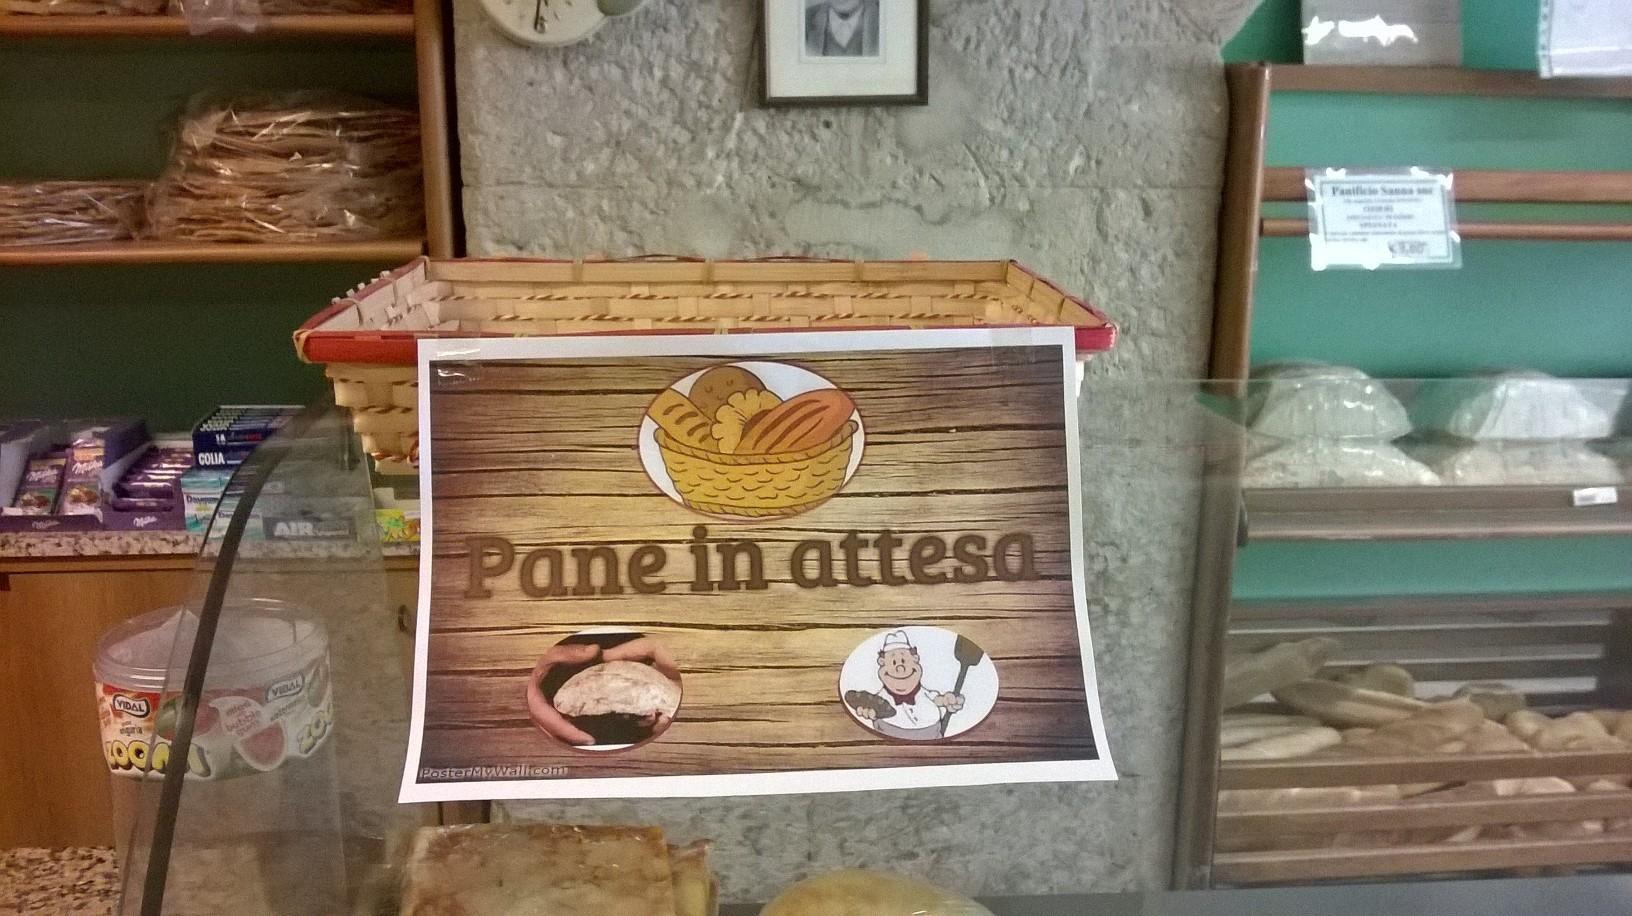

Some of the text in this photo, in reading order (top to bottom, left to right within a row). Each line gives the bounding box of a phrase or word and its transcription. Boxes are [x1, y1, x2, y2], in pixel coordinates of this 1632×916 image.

[462, 524, 1041, 600] Pane in attesa
[116, 699, 145, 713] VIDAL
[420, 764, 569, 779] PosterMyWall.com
